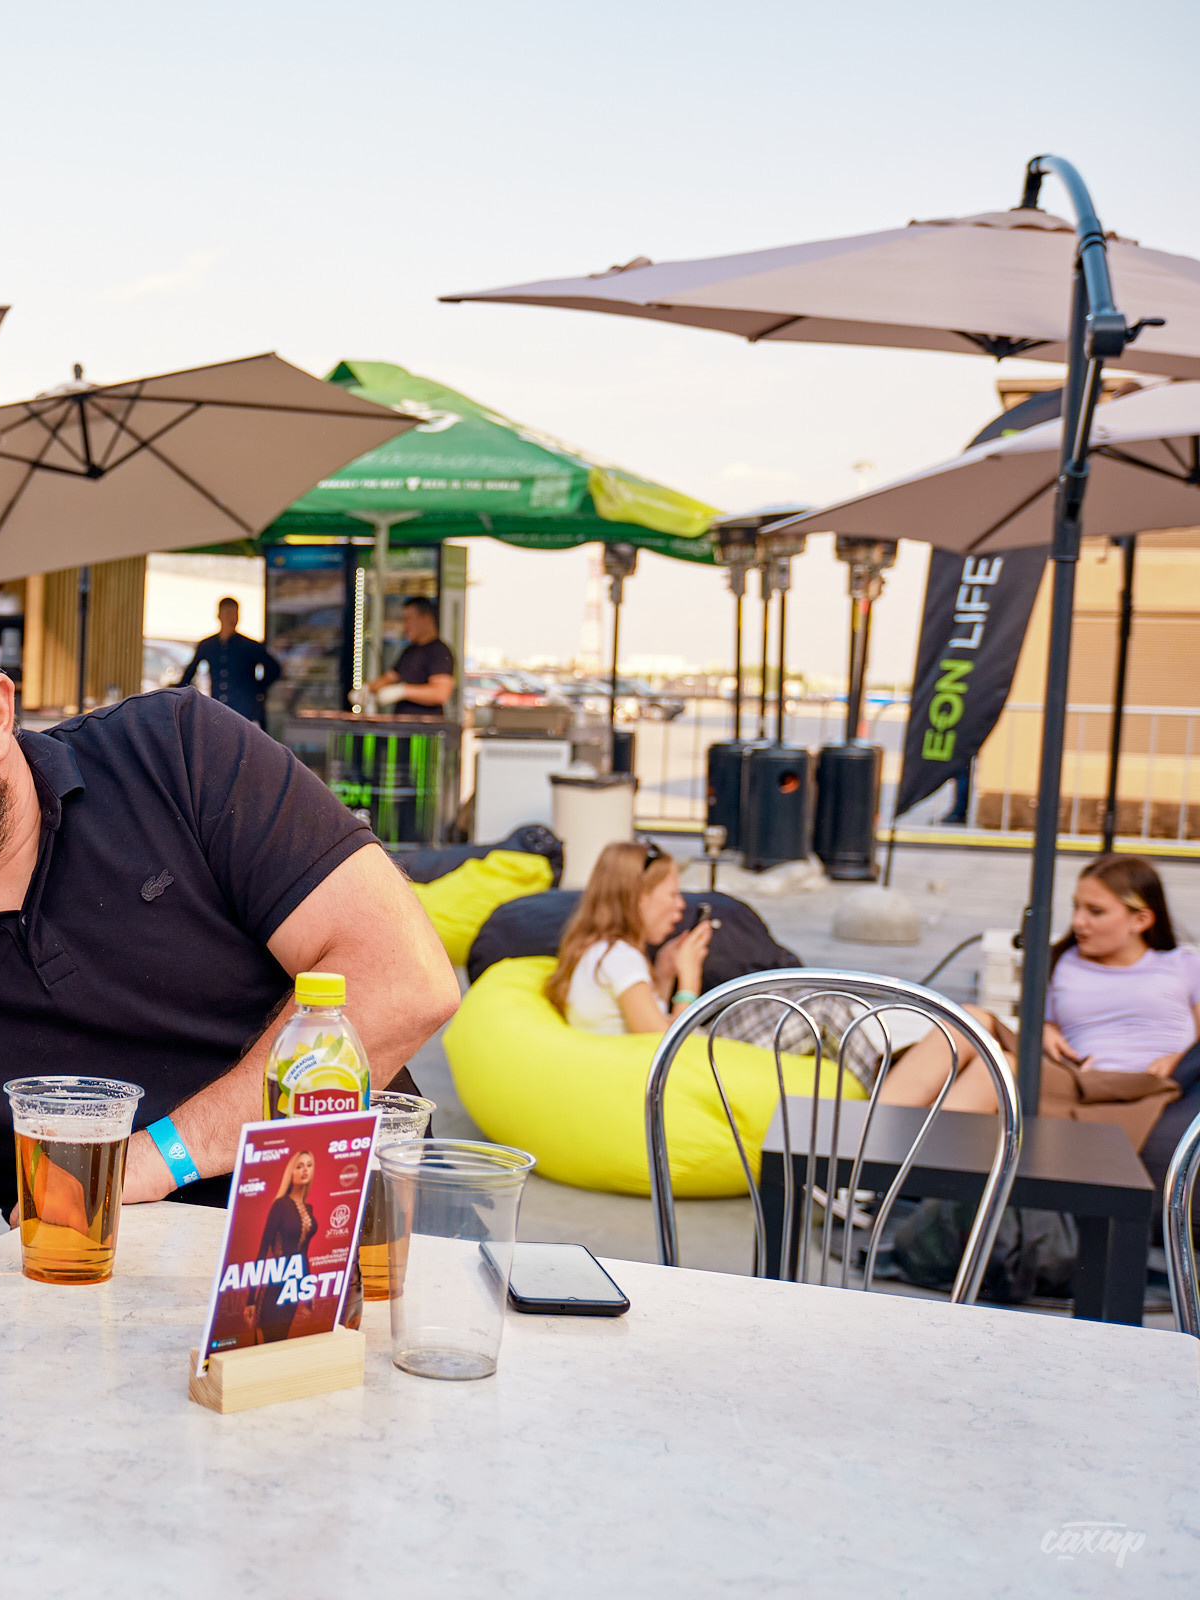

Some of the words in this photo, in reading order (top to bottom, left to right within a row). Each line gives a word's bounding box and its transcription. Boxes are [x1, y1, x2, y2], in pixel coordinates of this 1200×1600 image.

[948, 555, 1004, 649] LIFE
[921, 657, 976, 762] EON
[299, 1095, 355, 1115] Lipton
[218, 1253, 304, 1292] ANNA
[276, 1270, 345, 1305] ASTI
